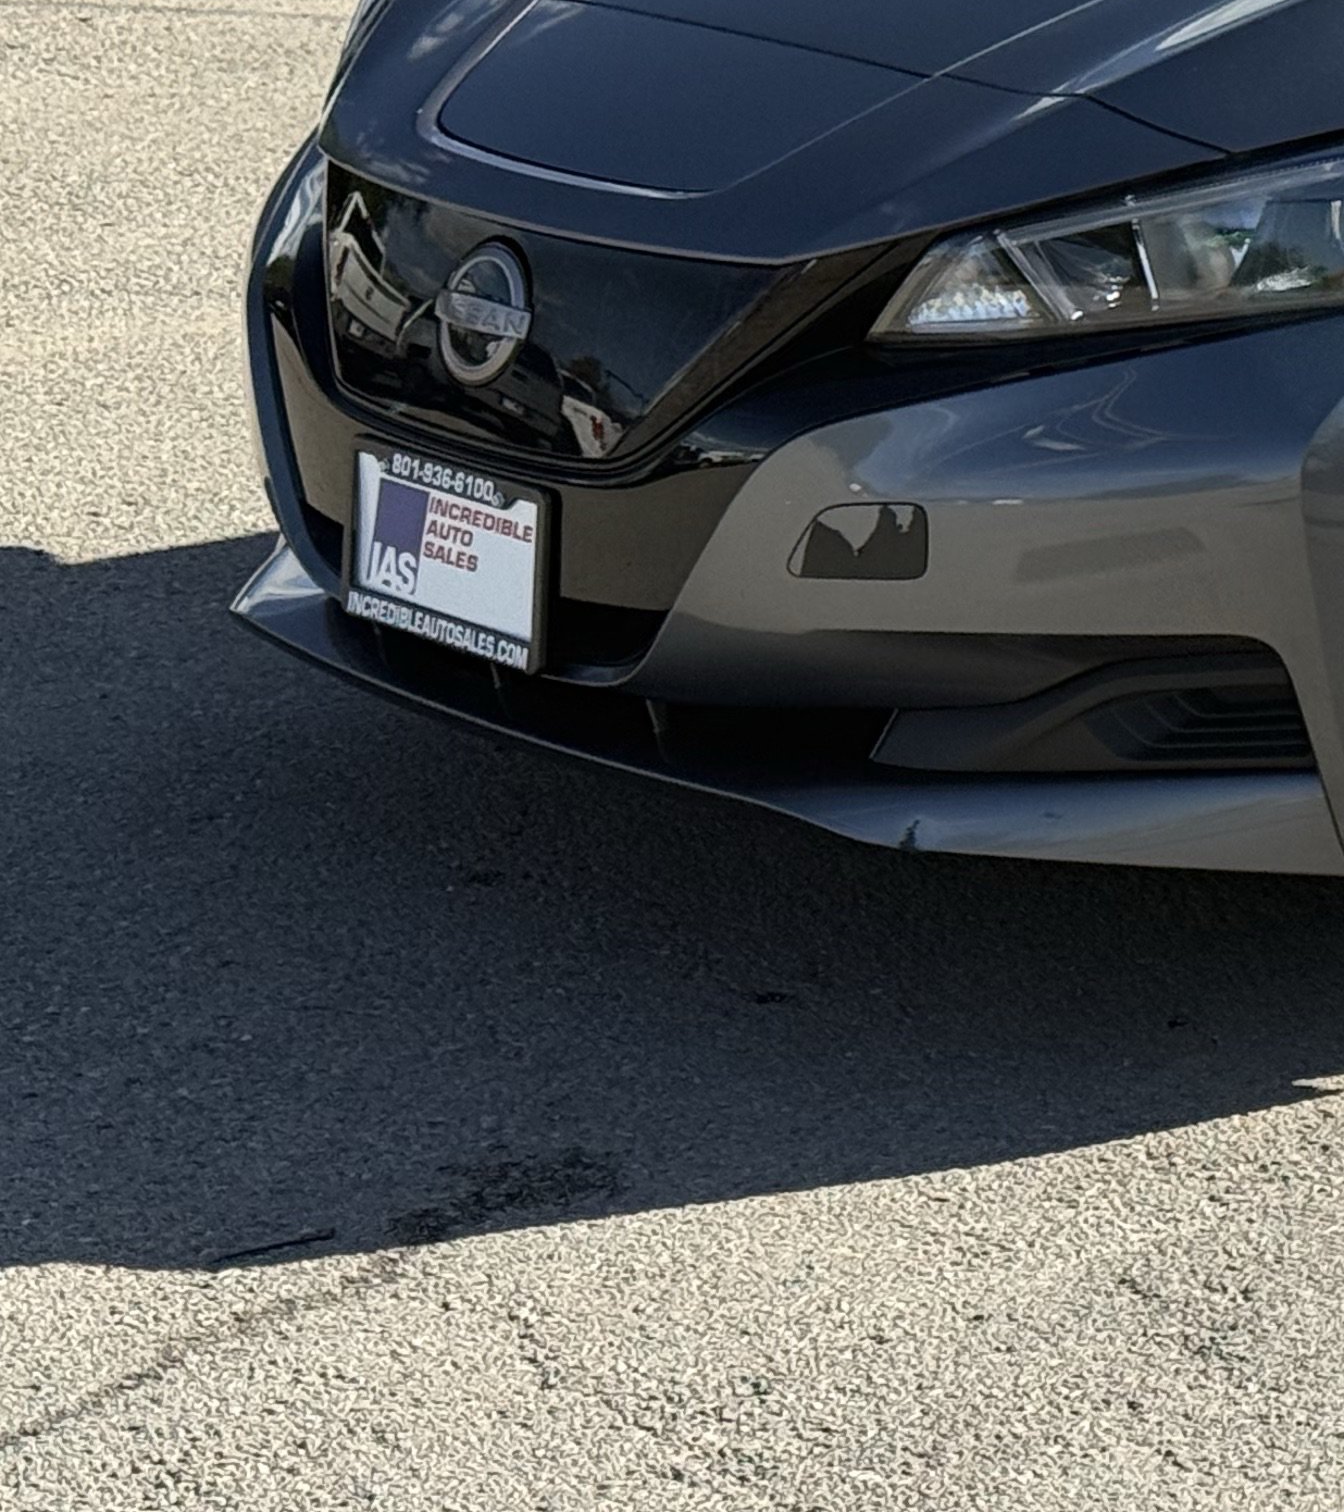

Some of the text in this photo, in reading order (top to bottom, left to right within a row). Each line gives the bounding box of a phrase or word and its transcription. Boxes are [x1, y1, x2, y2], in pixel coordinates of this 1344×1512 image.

[391, 452, 495, 503] 801-936-6100
[425, 519, 474, 548] AUTO
[428, 495, 534, 544] INCREDIBLE
[366, 541, 418, 596] IAS
[422, 541, 479, 573] SALES
[346, 590, 530, 672] INCREDIBLEAUTOSALES.COM
